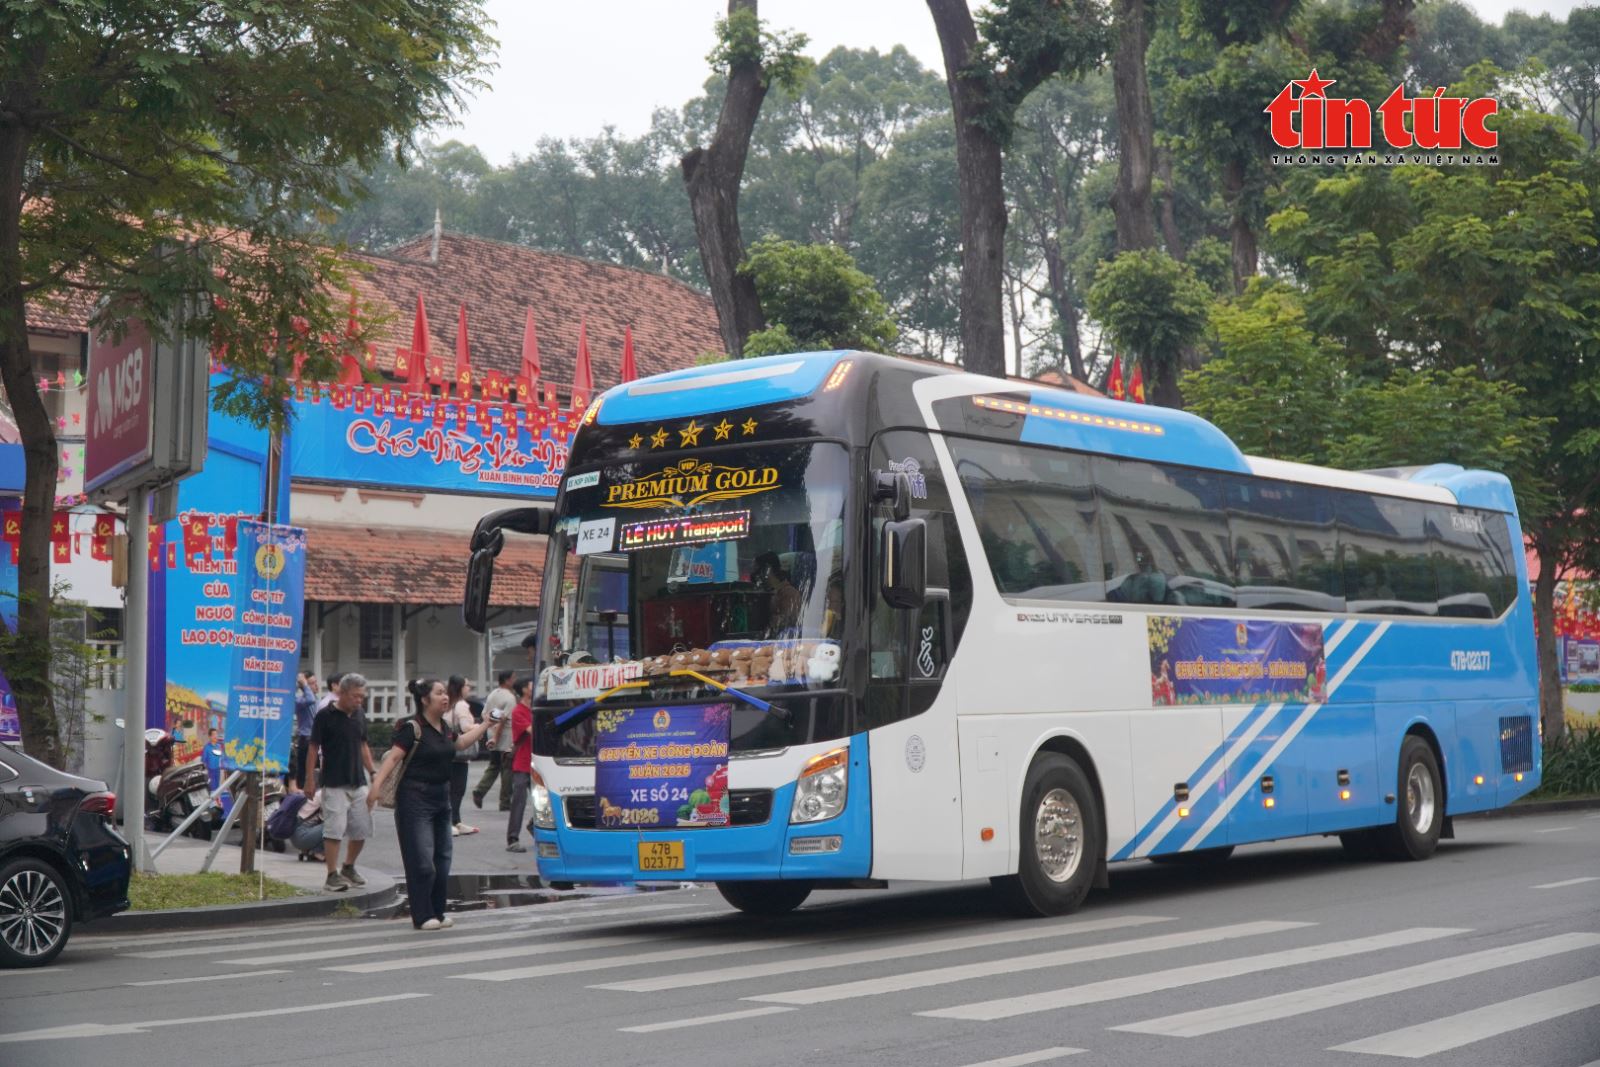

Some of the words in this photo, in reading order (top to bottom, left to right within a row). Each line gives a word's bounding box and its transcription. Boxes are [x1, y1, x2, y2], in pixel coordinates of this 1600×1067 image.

[113, 347, 143, 419] MSB
[680, 462, 695, 470] VIP
[479, 470, 501, 484] XUÂN
[524, 475, 541, 489] NGỌ
[541, 474, 562, 488] 202
[607, 475, 708, 502] PREMIUM
[714, 466, 779, 490] GOLD
[581, 531, 595, 541] XE
[597, 527, 610, 539] 24
[646, 523, 679, 541] HUY
[682, 516, 744, 538] Transport
[203, 579, 230, 598] CỦA
[242, 610, 266, 625] CÔNG
[267, 612, 292, 628] ĐOÀN
[181, 629, 207, 644] LAO
[234, 633, 257, 647] XUÂN
[274, 638, 297, 654] NGỌ
[243, 656, 261, 671] NĂM
[238, 705, 281, 721] 2026
[642, 746, 659, 759] XE
[660, 742, 691, 759] CÔNG
[693, 740, 728, 757] ĐOÀN
[629, 762, 662, 779] XUÂN
[662, 764, 691, 777] 2026
[631, 789, 648, 802] XE
[650, 782, 669, 802] SỐ
[671, 788, 688, 801] 24
[621, 808, 659, 824] 2026
[651, 843, 671, 855] 47B
[643, 856, 679, 869] 023.77
